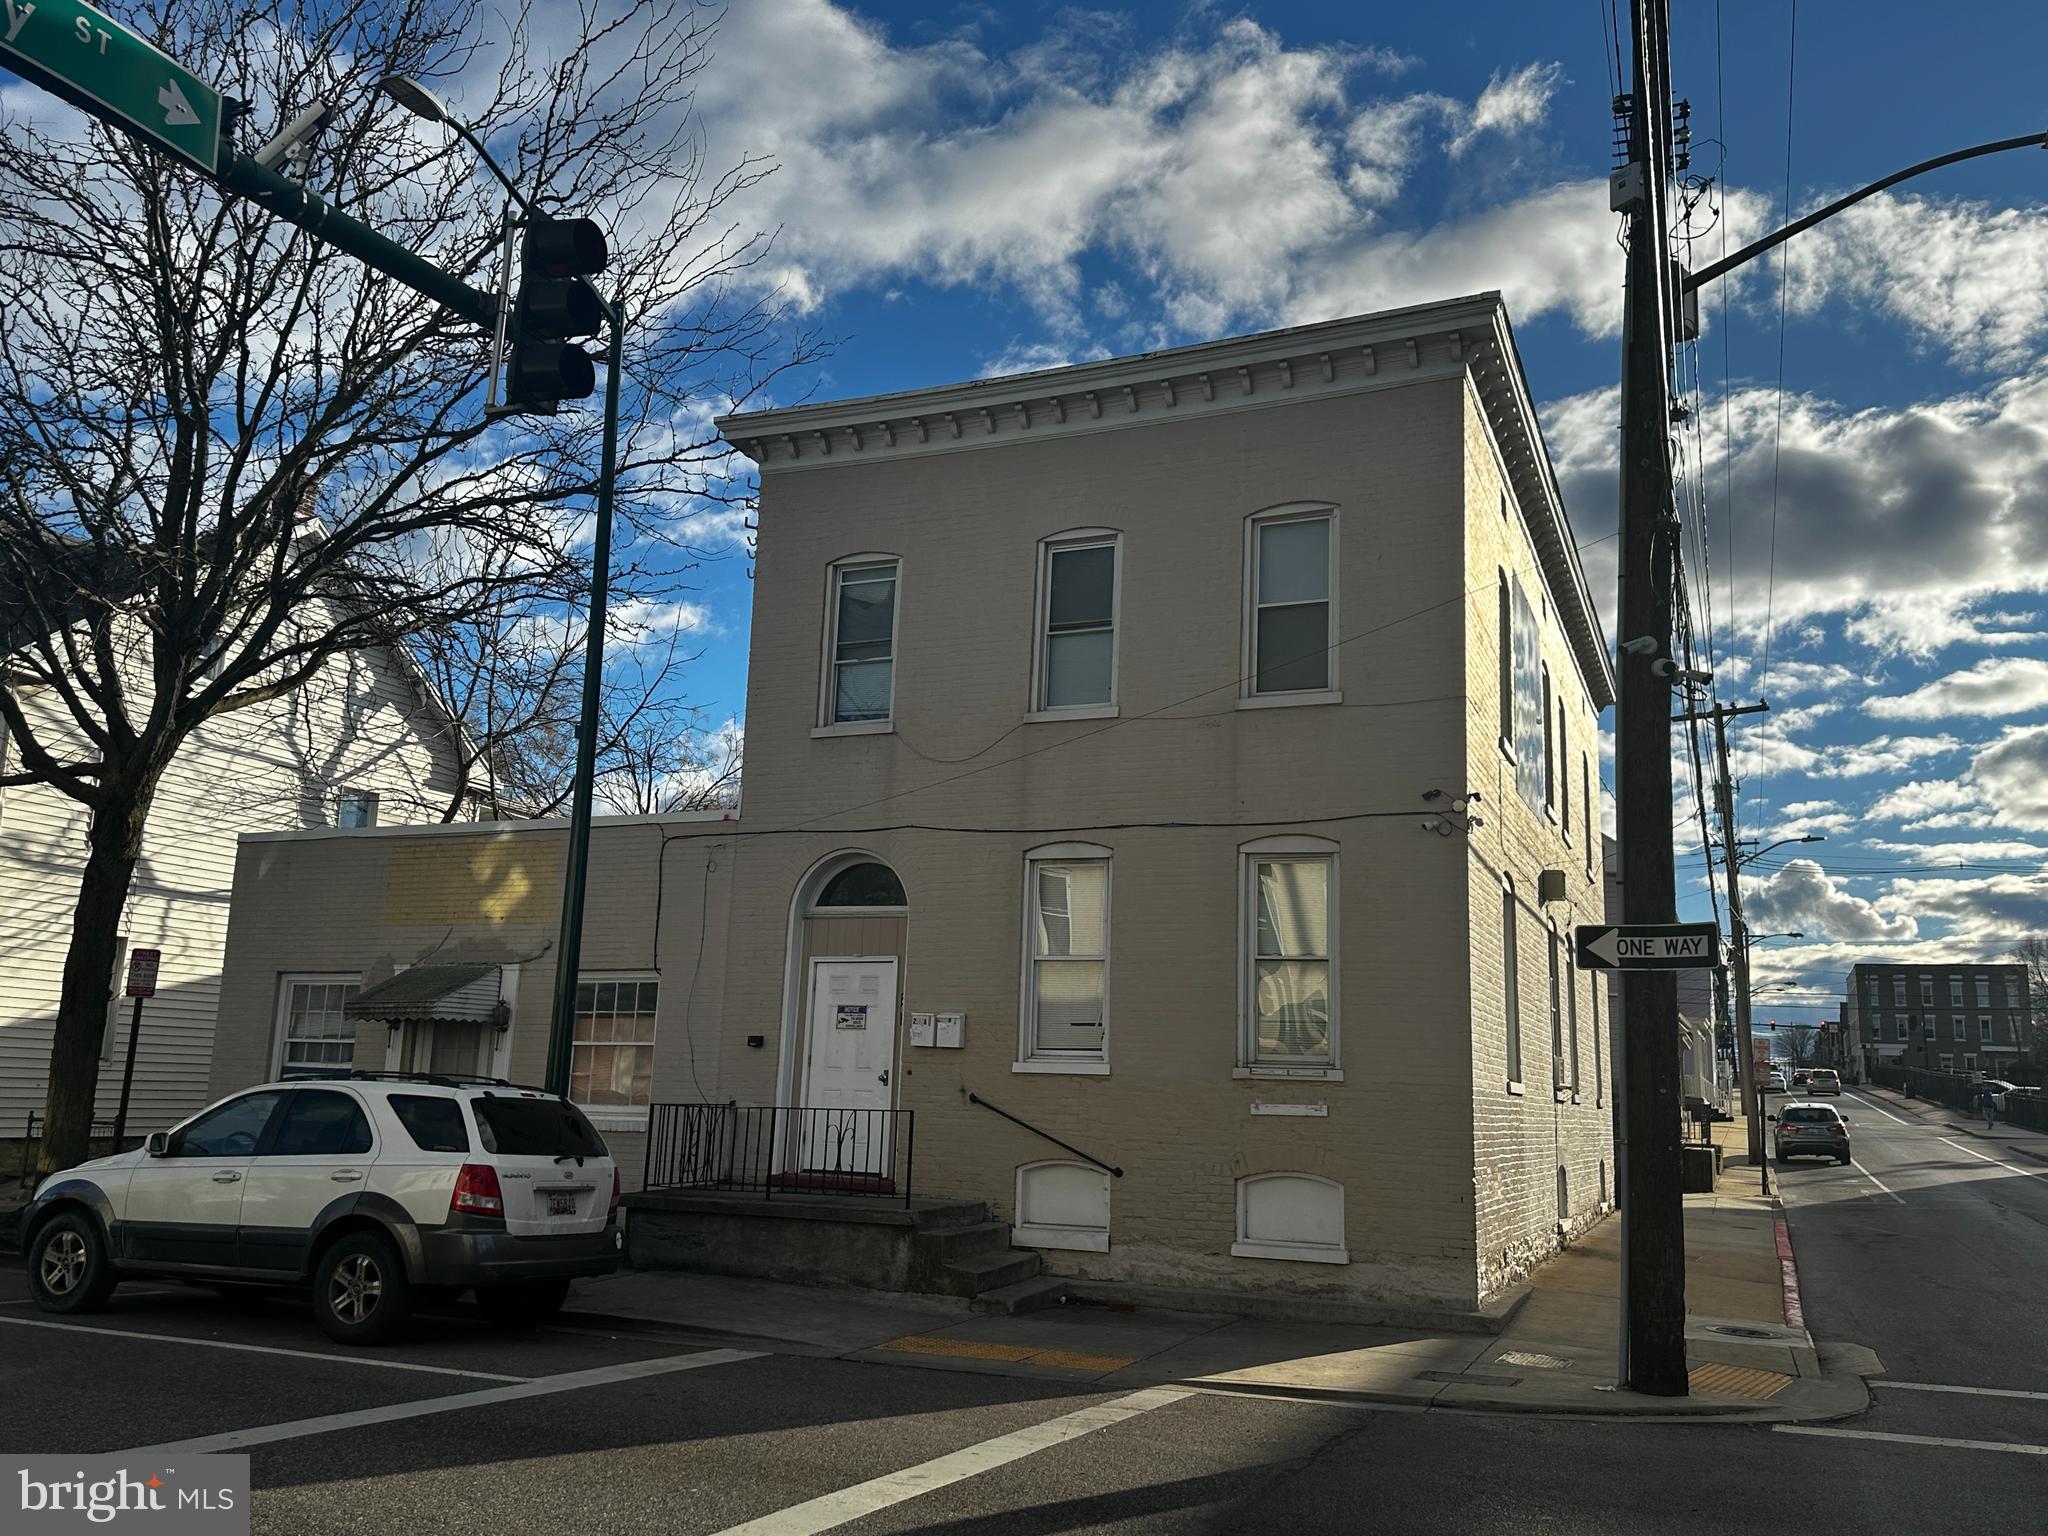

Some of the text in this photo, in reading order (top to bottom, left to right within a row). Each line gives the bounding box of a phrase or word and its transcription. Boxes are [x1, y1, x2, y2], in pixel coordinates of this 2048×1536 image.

[75, 16, 112, 55] ST
[1616, 937, 1702, 956] ONE WAY
